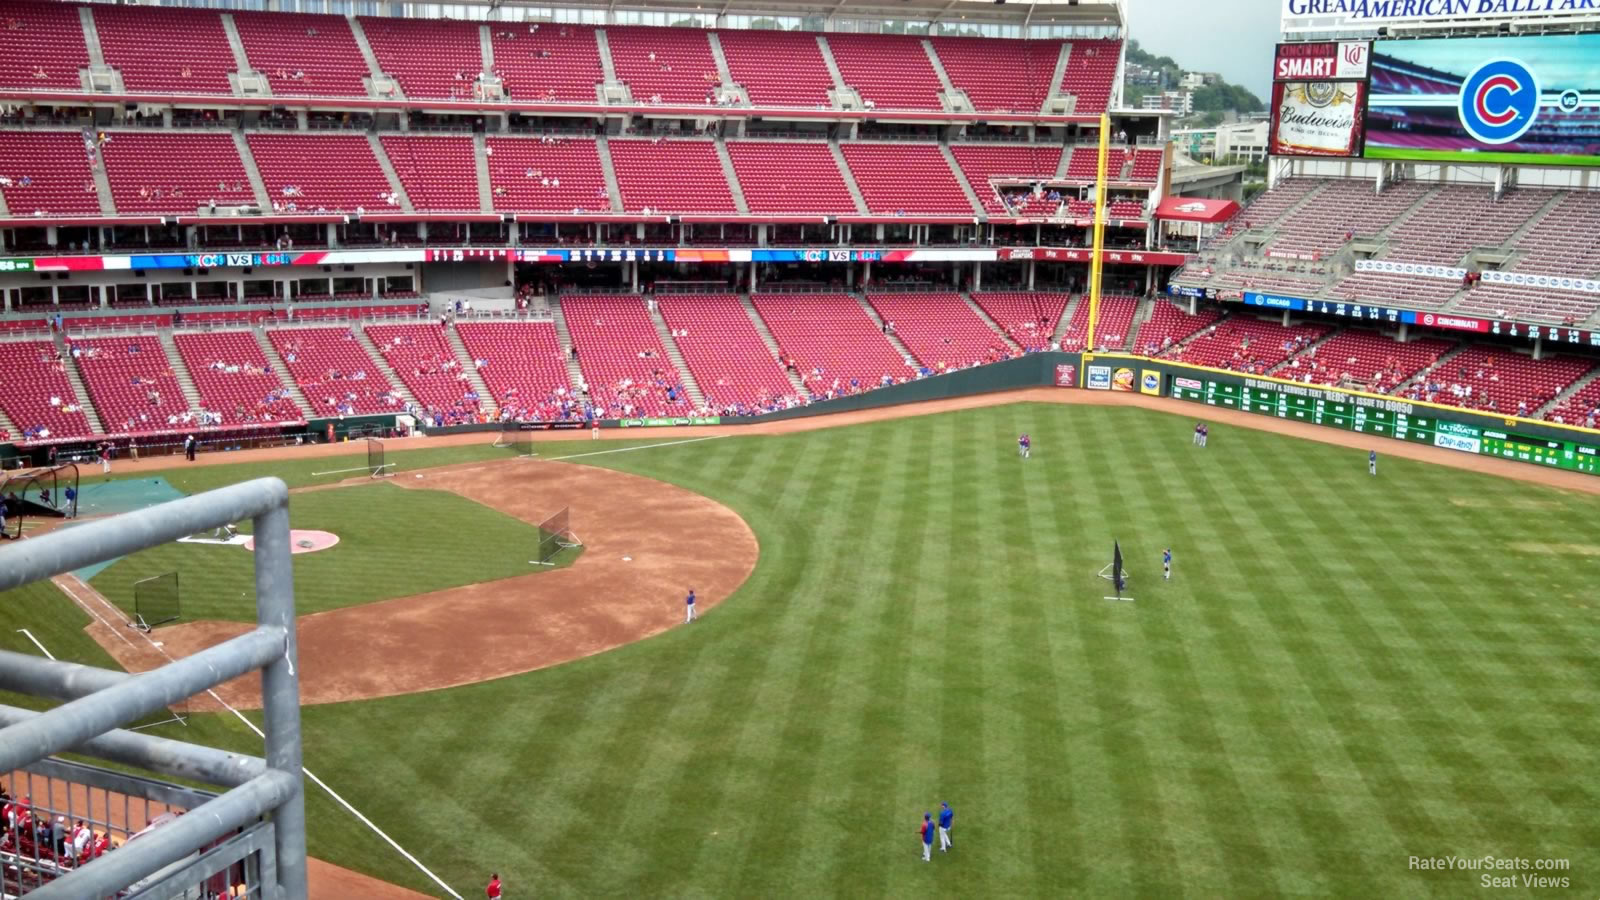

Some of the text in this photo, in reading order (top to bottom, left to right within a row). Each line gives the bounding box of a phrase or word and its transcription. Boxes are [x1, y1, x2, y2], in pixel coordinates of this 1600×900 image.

[1352, 0, 1470, 18] AMERICAN
[1279, 57, 1335, 77] SMART
[1563, 96, 1577, 105] VS
[1280, 105, 1353, 129] Budweiser
[230, 255, 249, 264] VS
[832, 251, 847, 260] VS
[1266, 297, 1290, 307] CHICAGO
[1437, 317, 1478, 329] CINCINNATI
[1245, 378, 1256, 387] FOR
[1257, 380, 1278, 391] SAFETY
[1277, 384, 1283, 392] &
[1283, 385, 1308, 396] SERVICE
[1308, 388, 1322, 398] TEXT
[1349, 396, 1355, 404] &
[1356, 397, 1375, 407] ISSUE
[1376, 399, 1385, 409] TO
[1385, 400, 1413, 415] 69050
[1439, 424, 1479, 436] ULTIMATE
[1578, 446, 1596, 455] LEAKE
